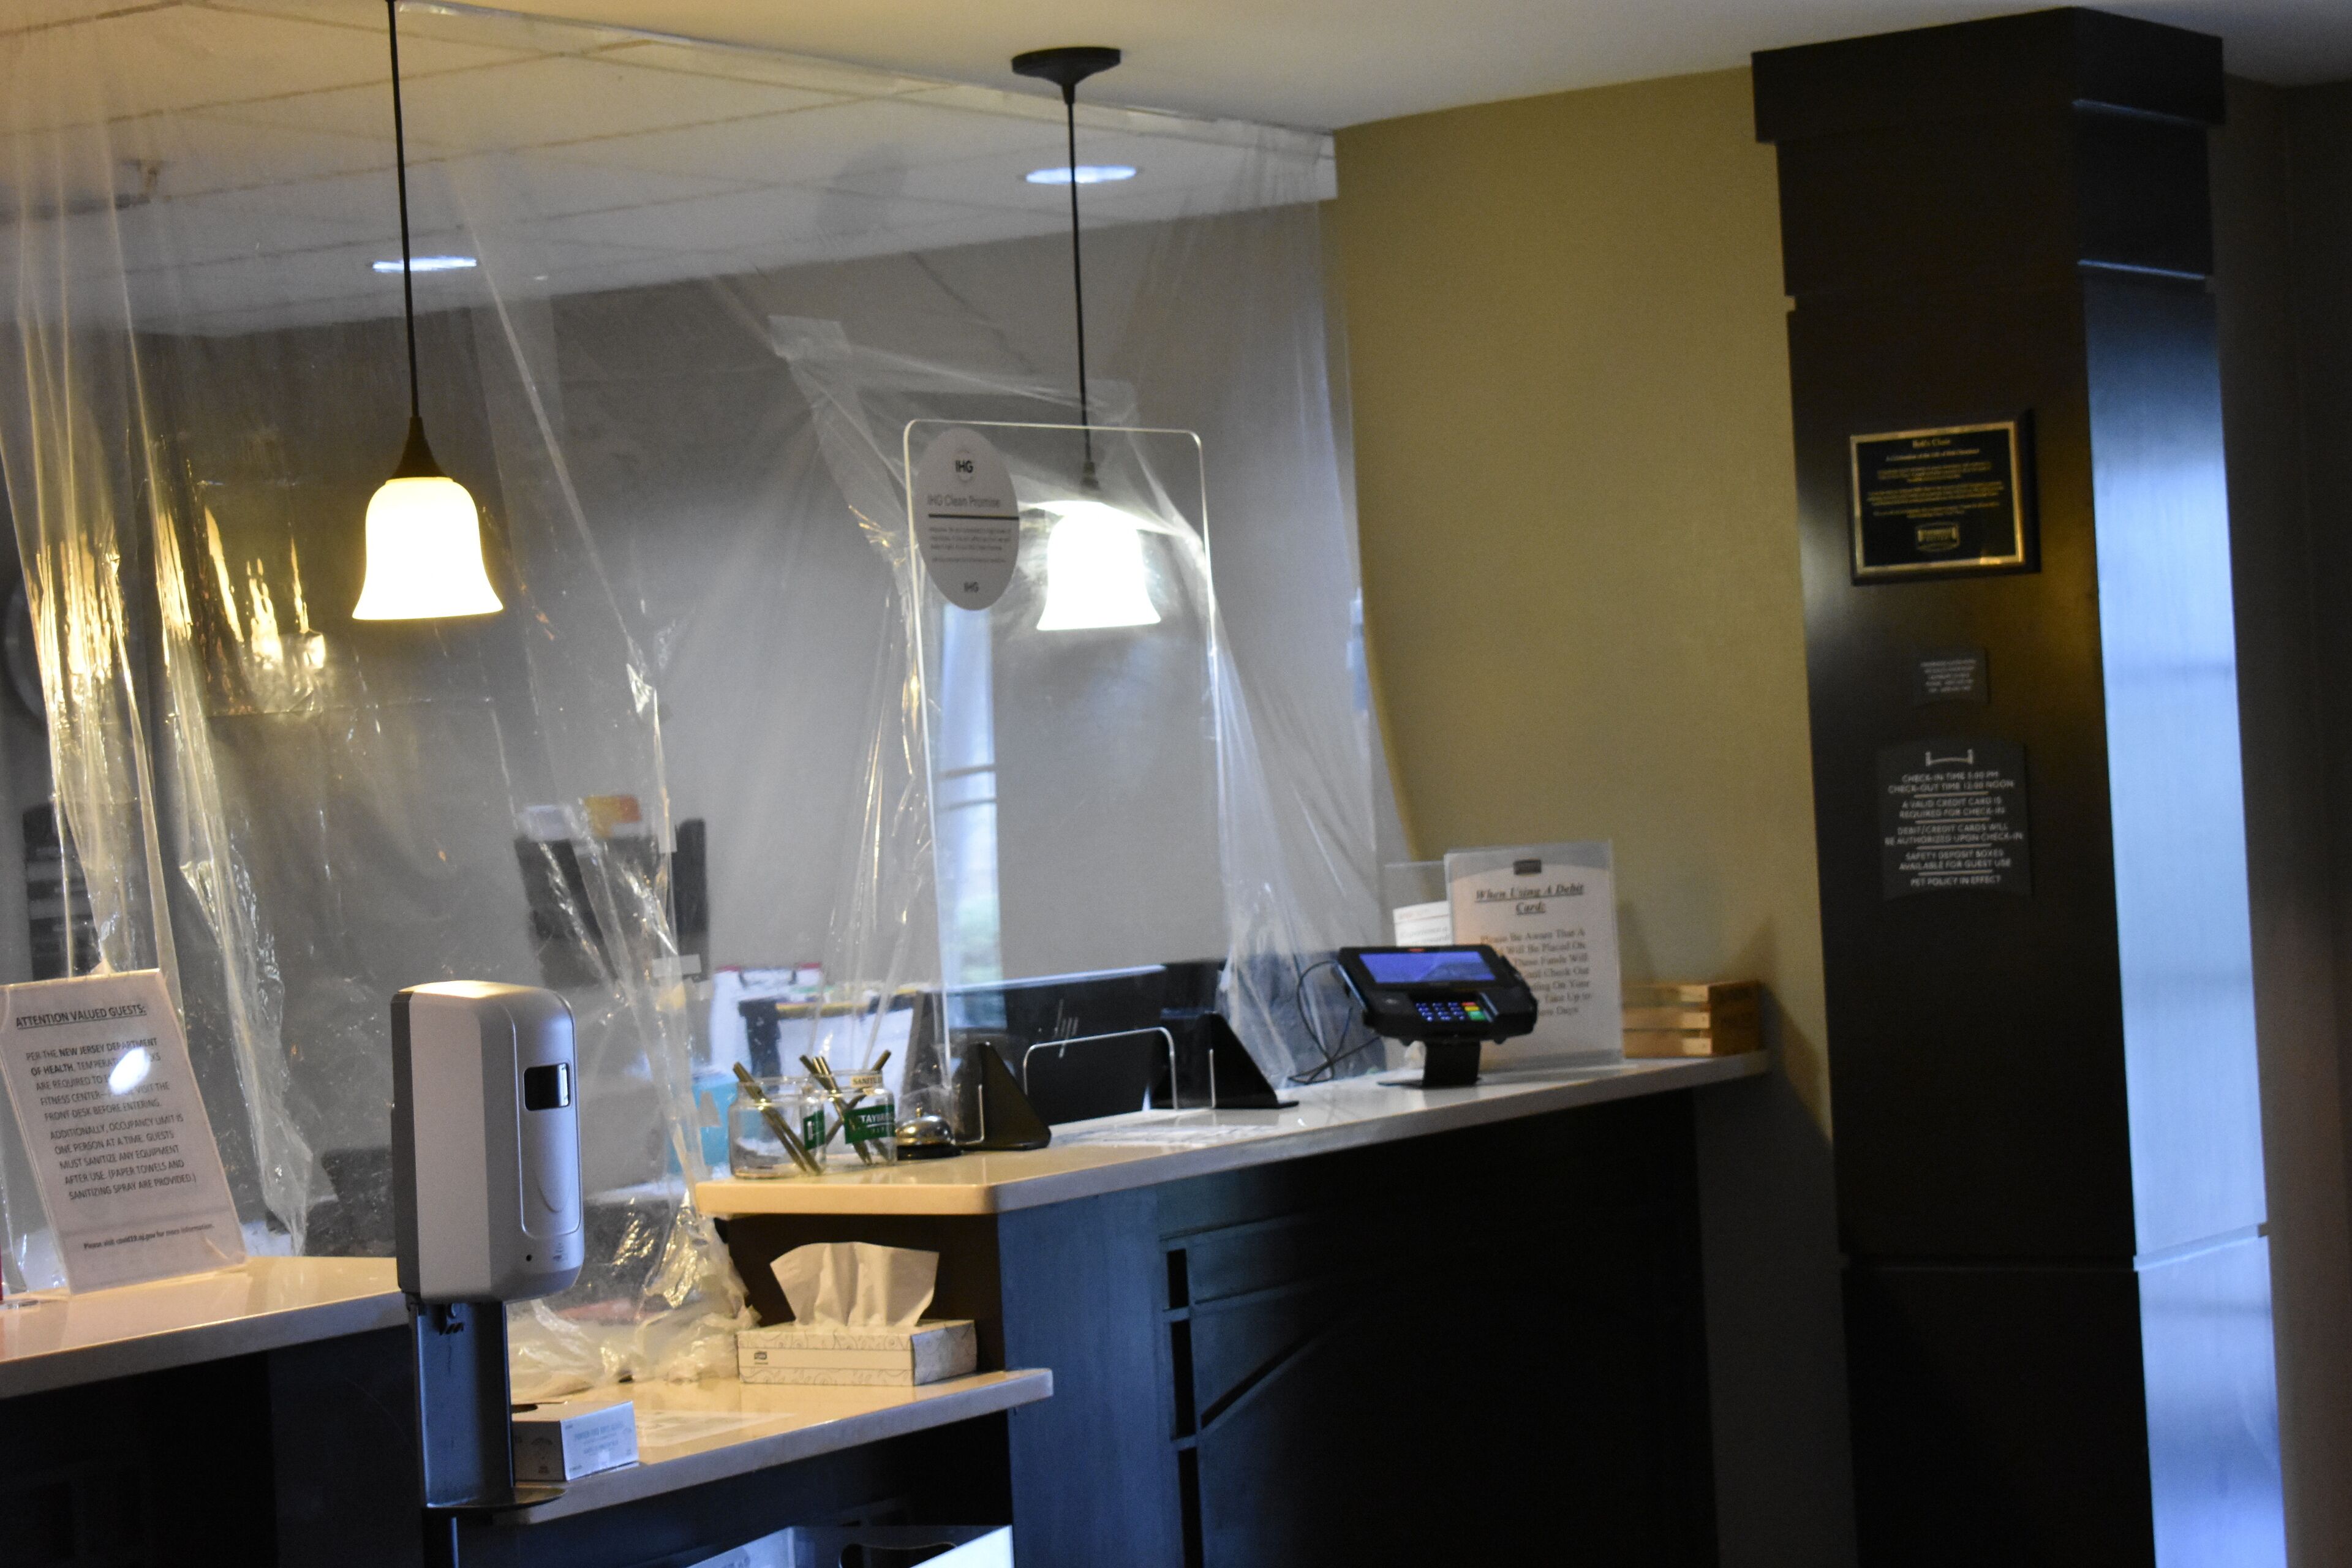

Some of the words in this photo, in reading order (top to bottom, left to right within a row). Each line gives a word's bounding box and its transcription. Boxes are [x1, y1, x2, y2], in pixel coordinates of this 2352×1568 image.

[955, 460, 974, 473] IHG
[927, 494, 943, 506] IHG
[944, 494, 968, 506] Clean
[968, 495, 1001, 508] Promise
[963, 582, 980, 593] IHG
[1902, 773, 1944, 783] CHECK-IN
[1946, 772, 1966, 780] TIME
[1986, 770, 1999, 778] PM
[1941, 782, 1961, 791] TIME
[1986, 778, 2015, 789] NOON
[1902, 800, 1909, 809] A
[1910, 799, 1935, 809] VALID
[1936, 797, 1967, 807] CREDIT
[1967, 796, 1992, 806] CARD
[1994, 796, 2002, 805] IS
[1899, 809, 1943, 820] REQUIRED
[1962, 807, 2005, 816] CHECK-IN
[1897, 824, 1956, 835] DEBIT/CREDIT
[1957, 823, 1987, 833] CARDS
[1988, 823, 2008, 831] WILL
[1884, 837, 1895, 846] BE
[1897, 835, 1953, 845] AUTHORIZED
[1954, 834, 1980, 843] UPON
[1980, 831, 2024, 842] CHECK-IN
[1905, 851, 1936, 861] SAFETY
[1938, 850, 1974, 859] DEPOSIT
[1975, 848, 2005, 858] BOXES
[1899, 860, 1943, 870] AVAILABLE
[1945, 859, 1962, 868] FOR
[1964, 859, 1992, 867] GUEST
[1994, 858, 2011, 867] USE
[1910, 877, 1927, 887] PET
[1927, 876, 1958, 886] POLICY
[1959, 876, 1970, 884] IN
[1970, 875, 2002, 884] EFFECT
[1476, 888, 1506, 899] When
[1510, 887, 1541, 900] Using
[1543, 885, 1553, 896] A
[1556, 883, 1585, 895] Debit
[1515, 901, 1546, 913] Card:
[1480, 935, 1507, 944] Please
[1509, 932, 1522, 941] Be
[1525, 932, 1553, 940] Aware
[1556, 929, 1575, 938] That
[1577, 928, 1586, 937] A
[1506, 944, 1525, 954] Will
[1527, 944, 1539, 953] Be
[1542, 941, 1570, 951] Placed
[1572, 940, 1586, 949] On
[1540, 955, 1567, 964] Funds
[1569, 952, 1588, 962] Will
[1543, 967, 1570, 977] Check
[1551, 981, 1566, 989] On
[16, 1012, 69, 1027] ATTENTION
[69, 1008, 107, 1021] VALUED
[108, 1004, 146, 1017] GUESTS:
[26, 1051, 42, 1061] PER
[42, 1049, 58, 1058] THE
[59, 1047, 78, 1057] NEW
[79, 1044, 105, 1055] JERSEY
[107, 1038, 157, 1052] DEPARTMENT
[31, 1067, 43, 1077] OF
[76, 1058, 119, 1071] TEMPERAT
[36, 1082, 51, 1091] ARE
[52, 1077, 91, 1088] REQUIRED
[91, 1074, 103, 1084] TO
[40, 1095, 70, 1106] FITNESS
[136, 1084, 154, 1094] VISIT
[155, 1082, 170, 1091] THE
[44, 1110, 70, 1121] FRONT
[72, 1107, 92, 1118] DESK
[92, 1103, 123, 1115] BEFORE
[123, 1098, 162, 1112] ENTERING.
[50, 1125, 108, 1140] ADDITIONALLY,
[108, 1118, 153, 1131] OCCUPANCY
[155, 1115, 175, 1126] LIMIT
[176, 1113, 184, 1122] IS
[55, 1144, 74, 1155] ONE
[74, 1140, 104, 1152] PERSON
[105, 1138, 115, 1147] AT
[117, 1137, 124, 1146] A
[146, 1130, 175, 1142] GUESTS
[59, 1158, 83, 1169] MUST
[83, 1153, 118, 1166] SANITIZE
[119, 1152, 134, 1161] ANY
[135, 1145, 179, 1158] EQUIPMENT
[65, 1174, 89, 1185] AFTER
[108, 1166, 135, 1179] (PAPER
[135, 1161, 167, 1174] TOWELS
[168, 1159, 184, 1169] AND
[69, 1185, 112, 1200] SANITIZING
[112, 1182, 137, 1193] SPRAY
[138, 1180, 153, 1189] ARE
[154, 1173, 197, 1186] PROVIDED.)
[116, 1234, 156, 1244] covid19.nj.gov
[180, 1224, 215, 1234] information.
